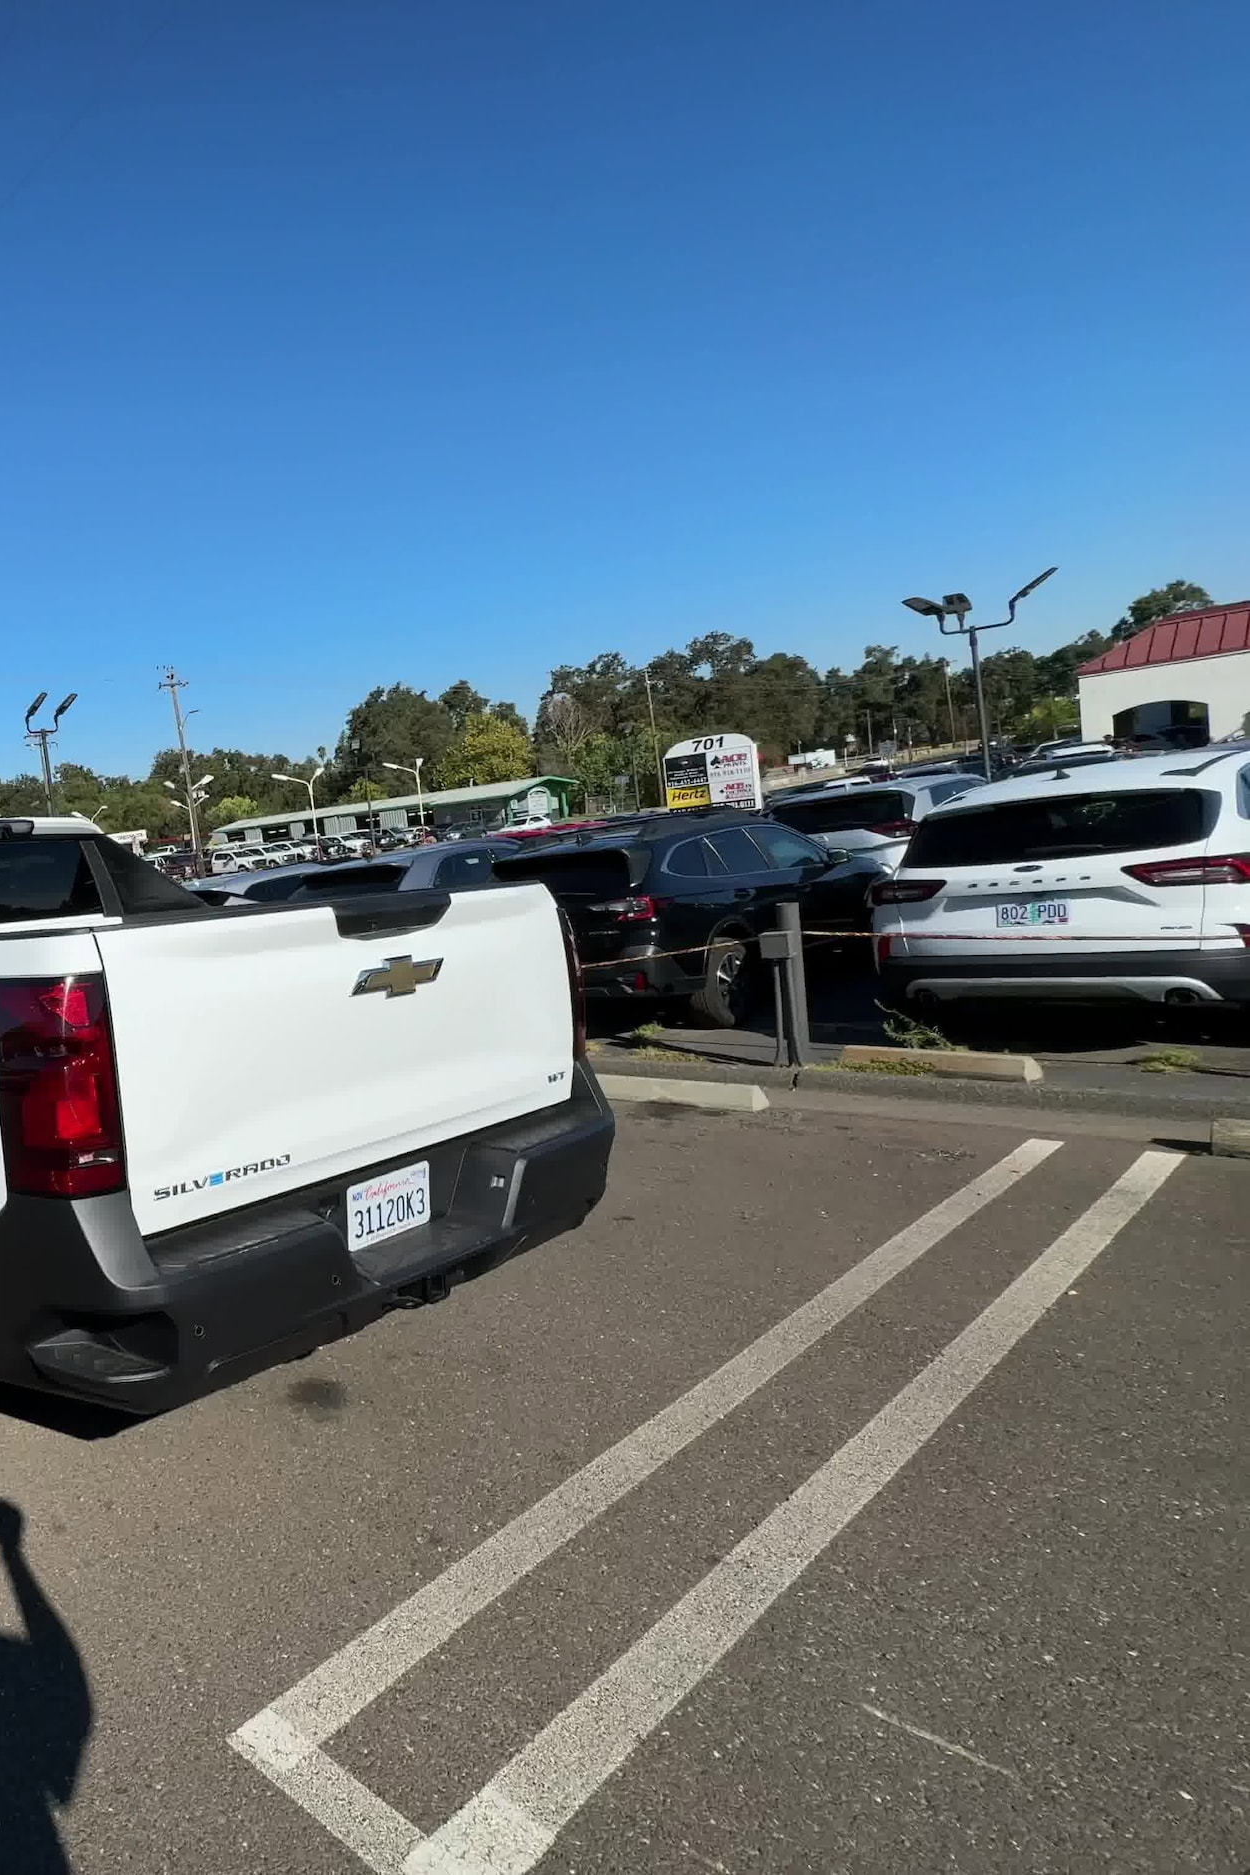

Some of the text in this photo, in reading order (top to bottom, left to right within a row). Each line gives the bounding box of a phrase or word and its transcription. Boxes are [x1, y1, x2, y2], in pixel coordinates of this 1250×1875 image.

[692, 736, 724, 752] 701
[672, 789, 707, 802] Hertz
[1001, 904, 1067, 920] 802 PDD
[153, 1153, 291, 1201] SILVERADO
[364, 1178, 415, 1200] California
[354, 1187, 425, 1239] 31120K3
